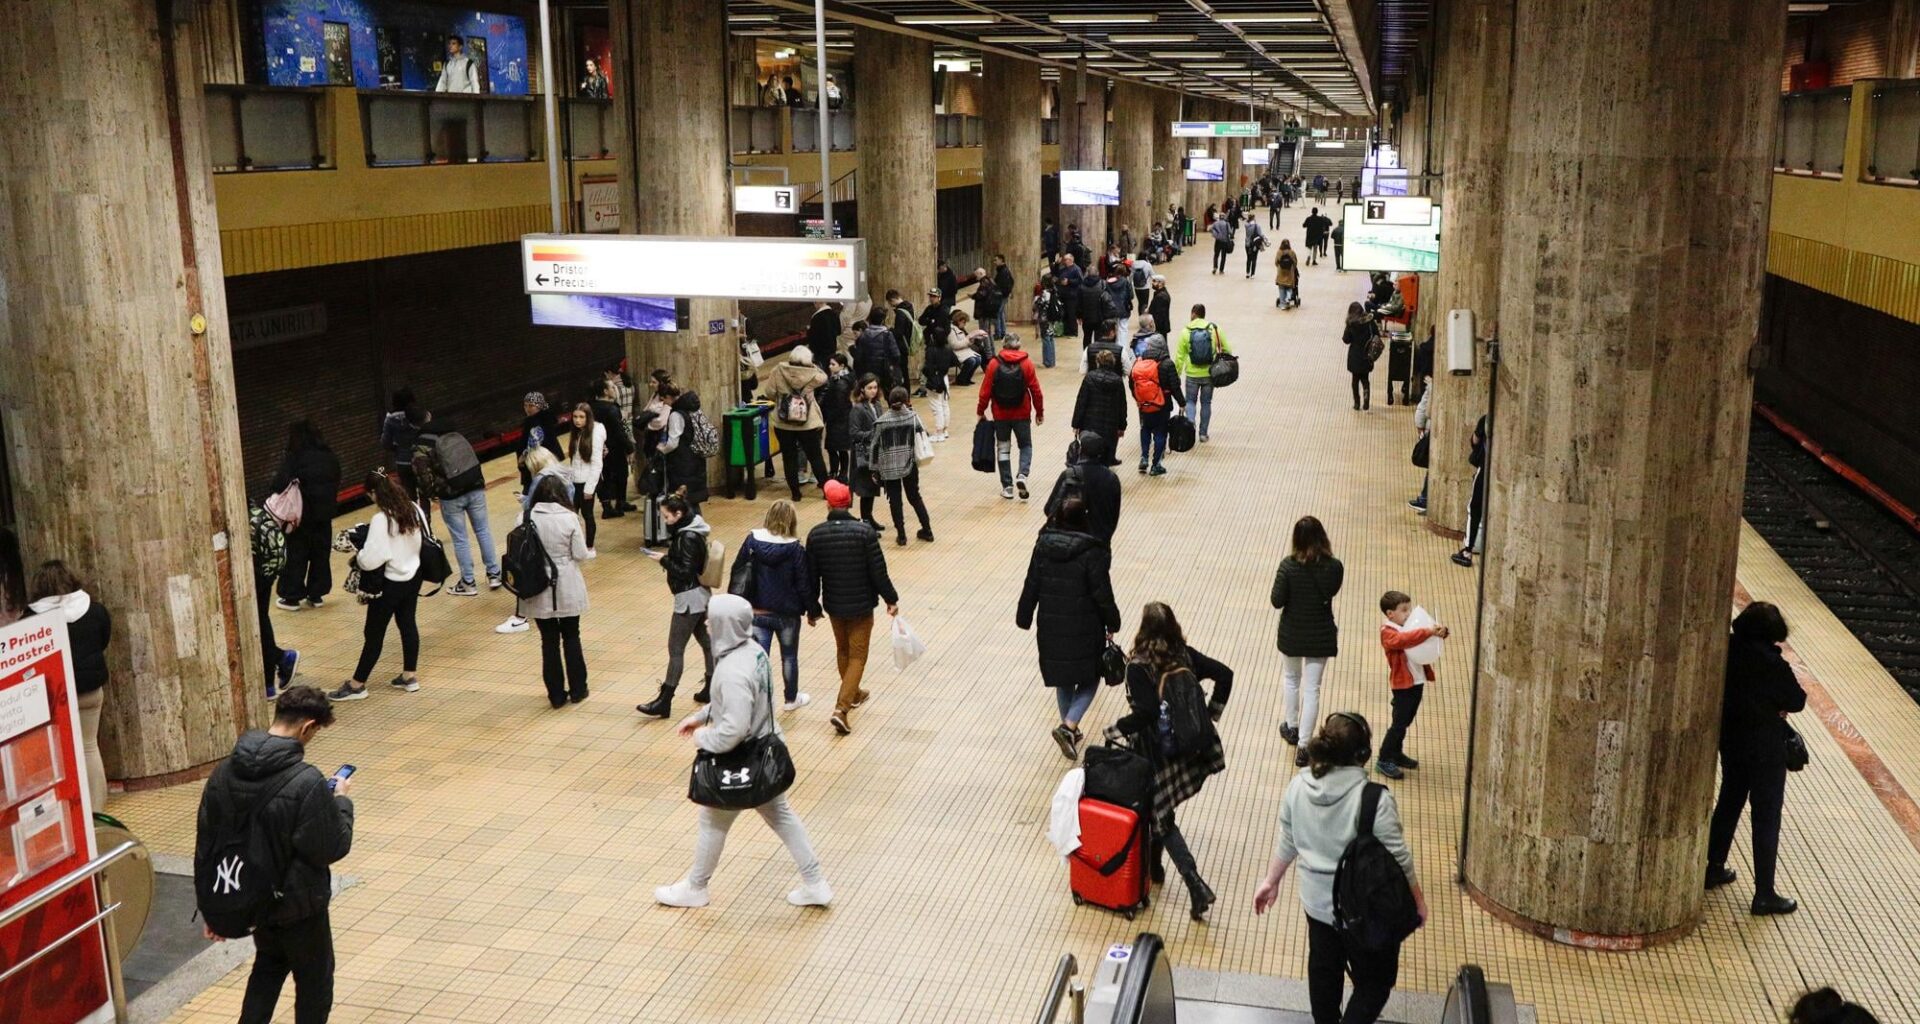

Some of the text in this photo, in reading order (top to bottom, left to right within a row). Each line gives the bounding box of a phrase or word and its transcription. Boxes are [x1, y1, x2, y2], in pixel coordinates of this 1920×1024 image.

[778, 197, 787, 207] 2
[1373, 206, 1379, 218] 1
[782, 282, 822, 296] Saligny
[9, 626, 53, 650] Prinde
[0, 638, 55, 670] noastre!
[213, 854, 245, 894] NY
